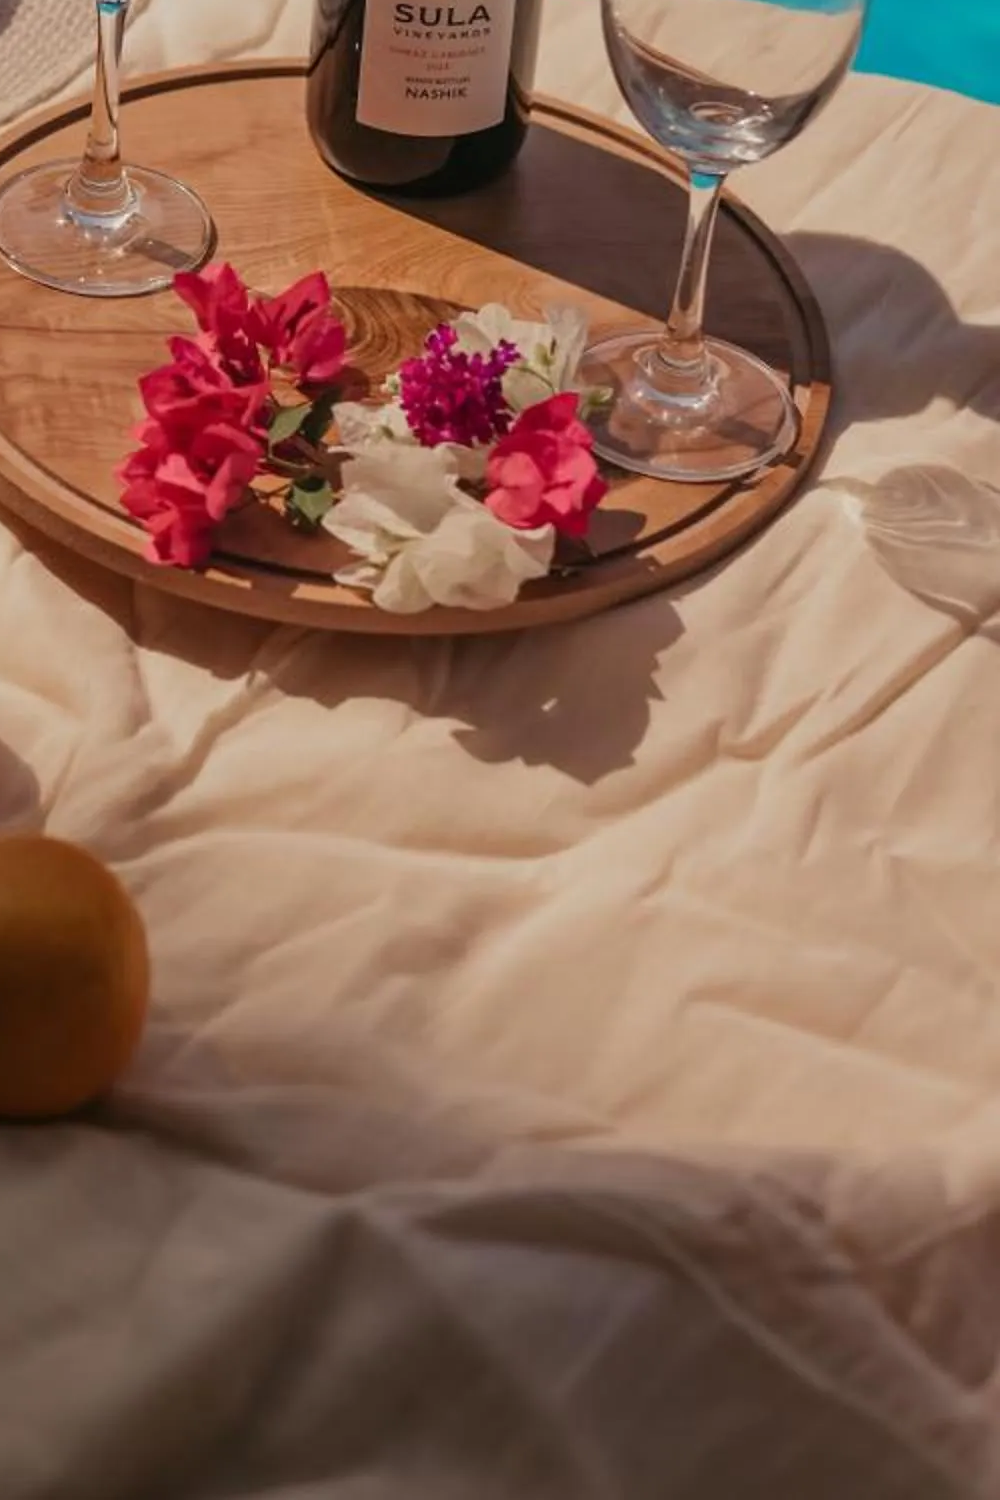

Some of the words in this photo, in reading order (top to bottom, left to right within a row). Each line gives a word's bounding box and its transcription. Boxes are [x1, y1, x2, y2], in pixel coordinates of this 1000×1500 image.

[394, 3, 491, 27] SULA
[393, 27, 492, 39] VINEYARDS
[405, 87, 468, 100] NASHIK
